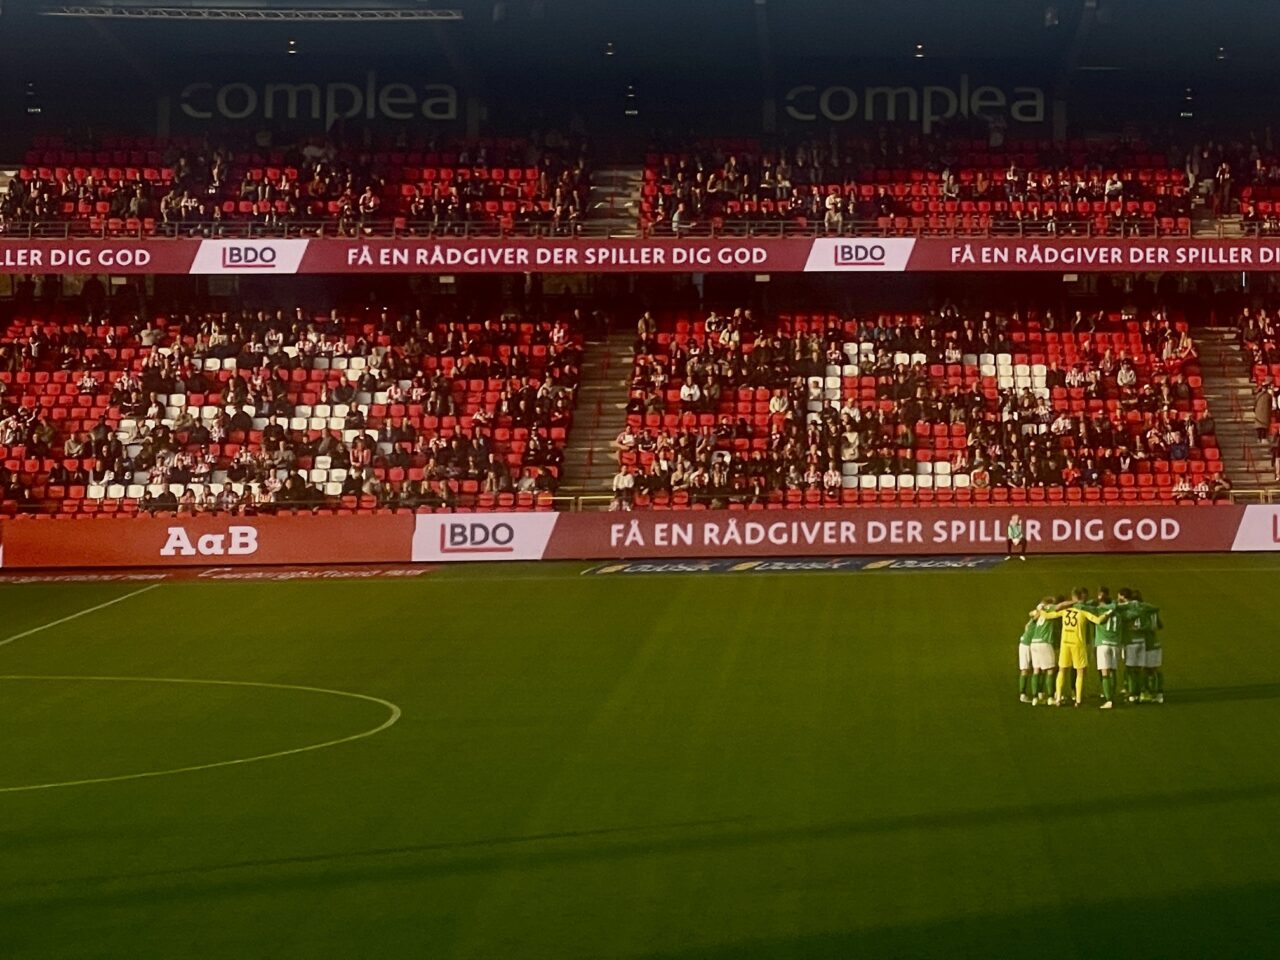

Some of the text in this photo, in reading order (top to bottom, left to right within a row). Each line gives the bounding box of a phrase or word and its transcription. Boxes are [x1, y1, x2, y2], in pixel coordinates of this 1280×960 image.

[180, 71, 457, 133] complea
[785, 74, 1045, 134] complea
[0, 249, 151, 266] LER DIG GOD
[228, 246, 277, 264] BDO
[347, 245, 768, 265] FÅ EN RÅDGIVER DER SPILLER DIG GOD
[840, 244, 886, 262] BDO
[951, 244, 976, 264] FÅ
[981, 247, 1009, 263] EN
[1015, 244, 1123, 264] RÅDGIVER
[1129, 247, 1169, 264] DER
[1175, 247, 1253, 264] SPILLER
[160, 525, 259, 556] AaB
[449, 522, 515, 547] BDO
[610, 518, 1180, 547] FÅ EN RÅDGIVER DER SPILLR DIG GOD
[1064, 609, 1079, 628] 33
